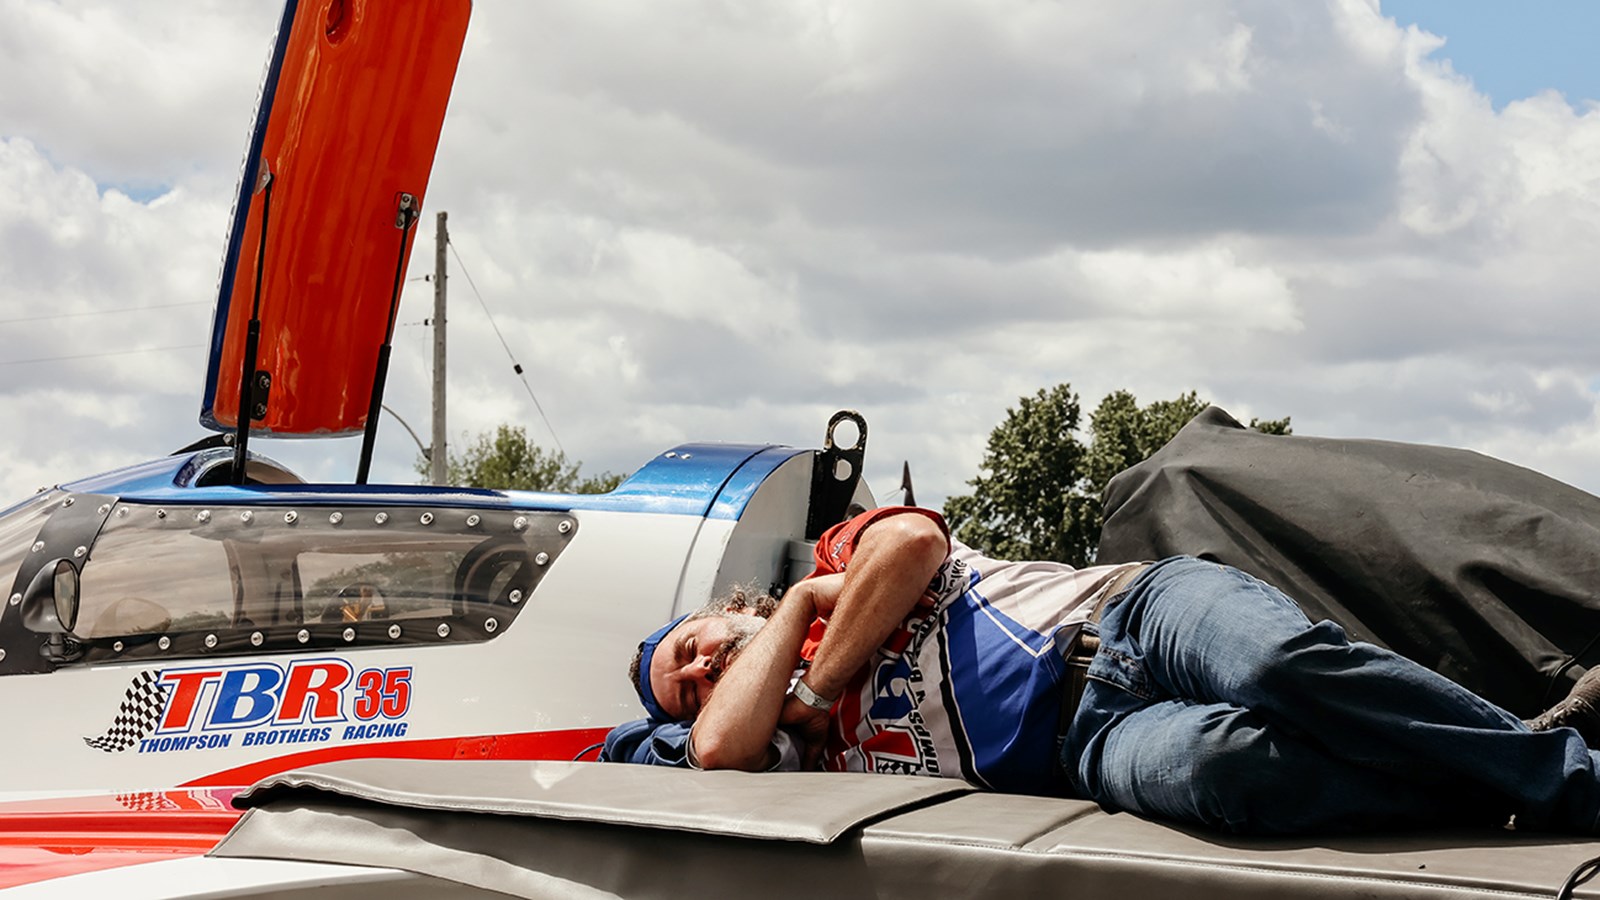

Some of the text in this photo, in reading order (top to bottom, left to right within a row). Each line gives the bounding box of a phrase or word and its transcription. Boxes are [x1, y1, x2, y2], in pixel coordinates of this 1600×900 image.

[156, 658, 413, 734] TBR 35
[138, 722, 408, 753] THOMPSON BROTHERS RACING
